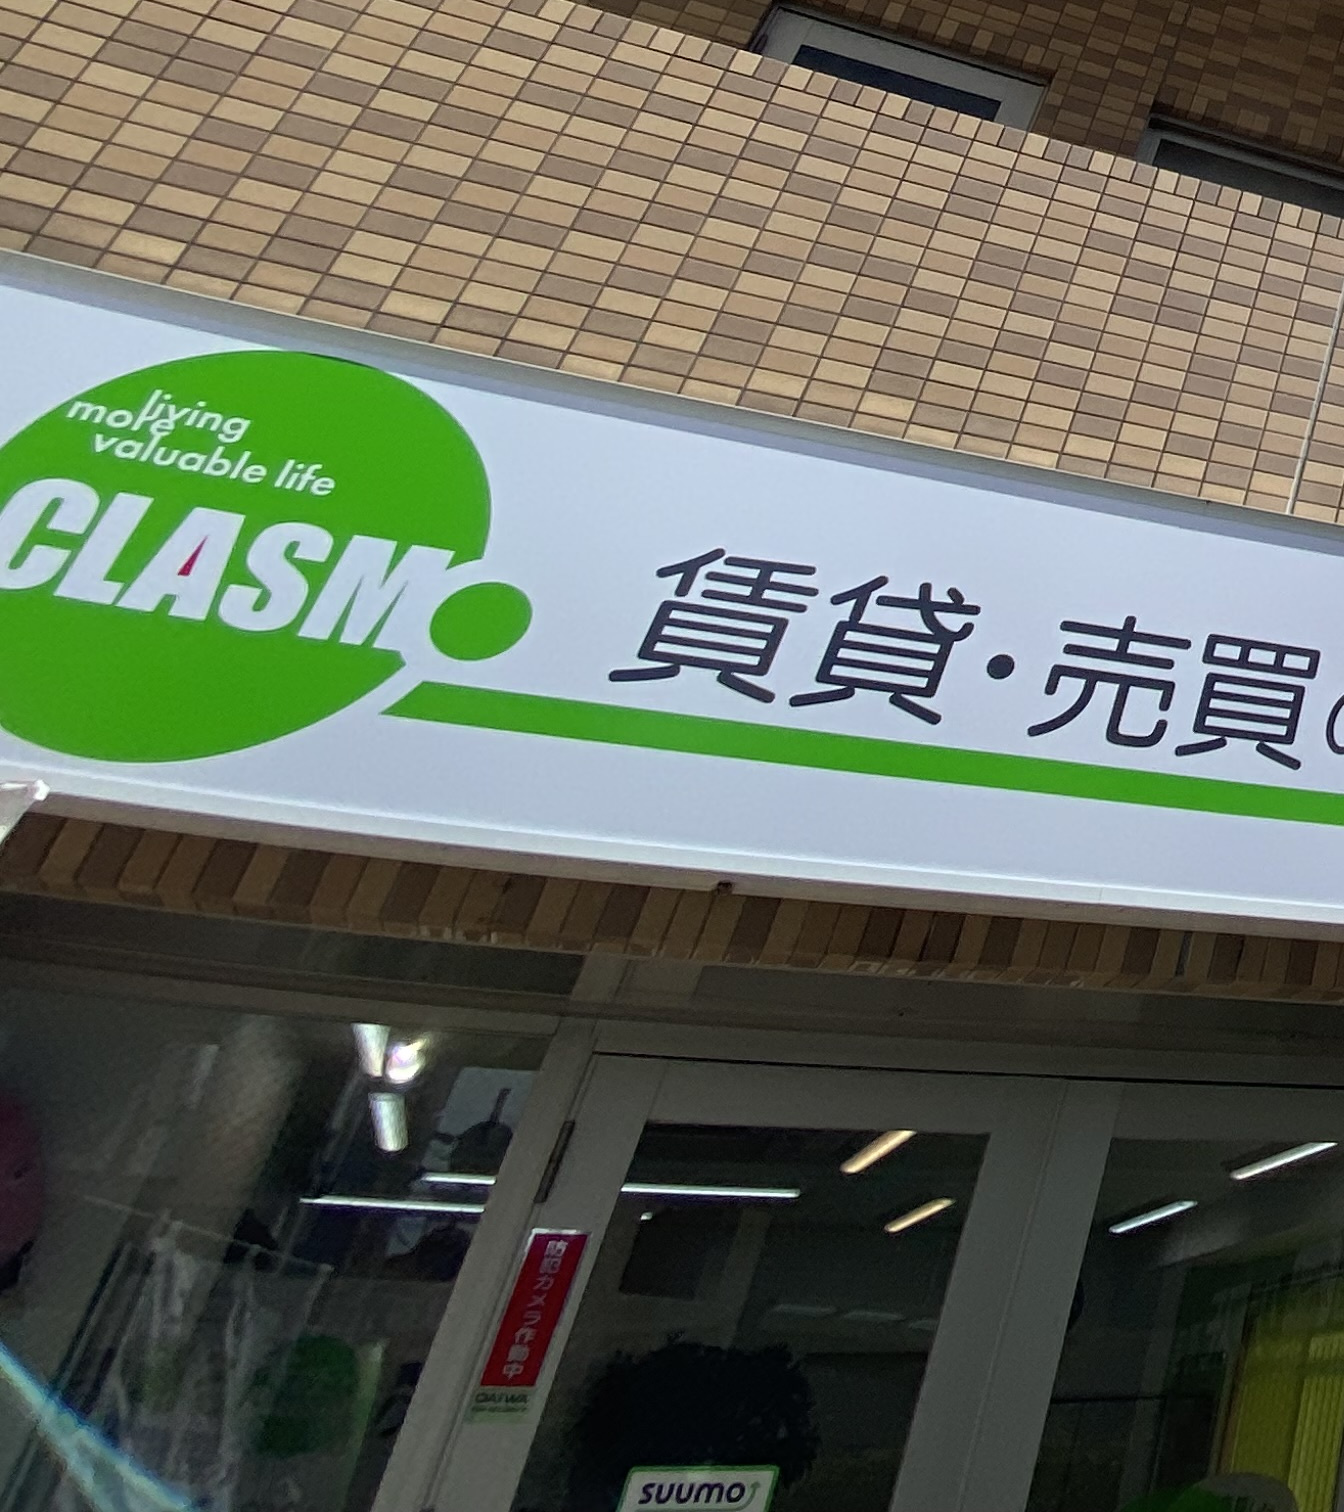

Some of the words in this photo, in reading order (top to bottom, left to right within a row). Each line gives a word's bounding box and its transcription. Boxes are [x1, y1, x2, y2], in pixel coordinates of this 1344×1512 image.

[142, 389, 250, 443] living
[93, 430, 267, 485] valuable
[274, 459, 335, 496] life
